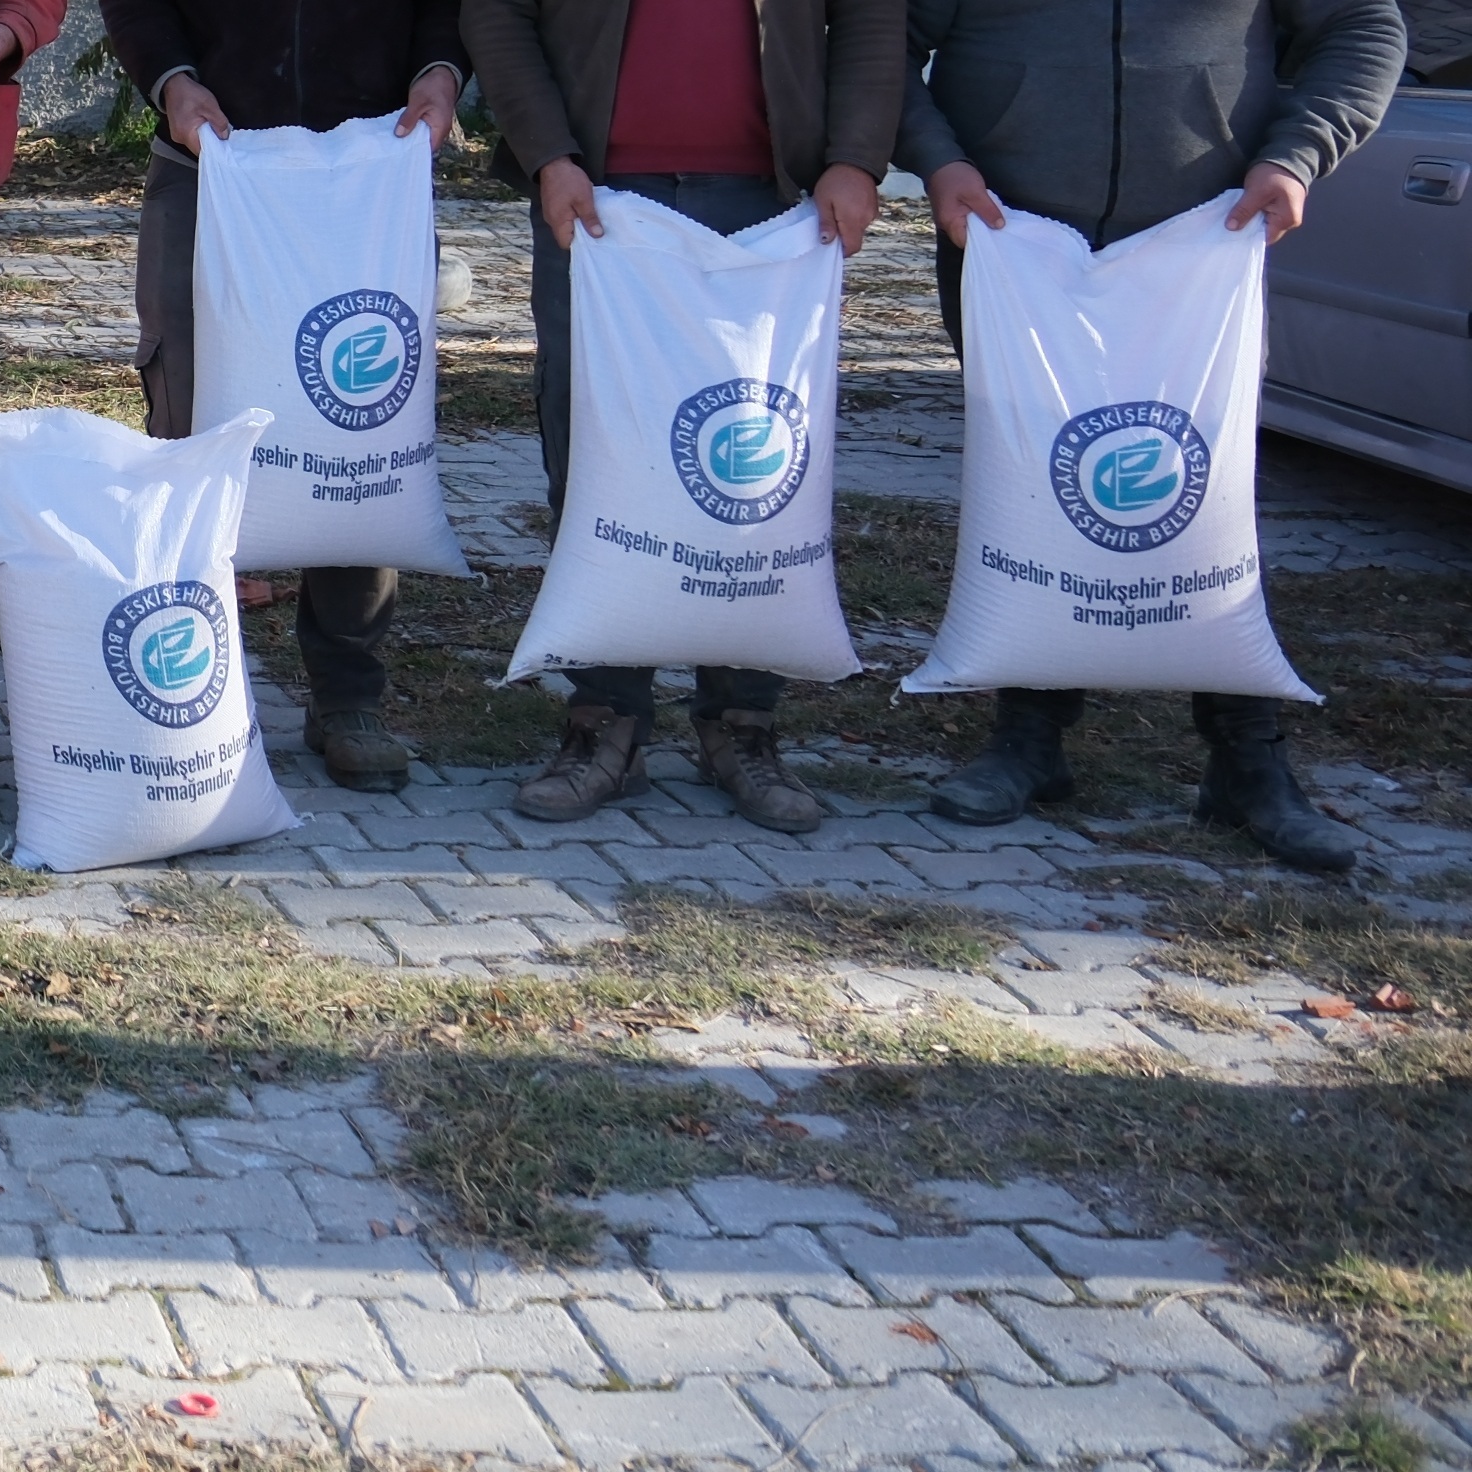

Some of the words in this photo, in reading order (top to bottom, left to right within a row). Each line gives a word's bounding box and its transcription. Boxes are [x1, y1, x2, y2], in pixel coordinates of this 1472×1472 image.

[319, 295, 400, 324] ESKİŞEHİR
[300, 333, 368, 427] BÜYÜKŞEHİR
[376, 330, 419, 422] BELEDİYESİ
[1078, 407, 1183, 437] ESKİŞEHİR
[250, 444, 298, 469] işehir
[303, 452, 387, 481] Büyükşehir
[391, 440, 435, 471] Belediyes
[676, 418, 749, 520] BÜYÜKŞEHİR
[313, 475, 403, 505] armağanıdır.
[1056, 445, 1140, 548] BÜYÜKŞEHİR
[1150, 442, 1206, 543] BELEDİYESİ
[595, 518, 668, 558] Eskişehir
[673, 541, 768, 576] Büyükşehir
[681, 575, 785, 602] armağanıdır.
[981, 544, 1055, 587] Eskişehir
[1060, 570, 1166, 605] Büyükşehir
[123, 586, 210, 621] ESKİŞEHİR
[1073, 601, 1191, 631] armağanıdır.
[107, 631, 191, 724] BÜYÜKŞEHİR
[196, 616, 227, 716] BELEDİYESİ
[52, 744, 126, 773] Eskişehir
[130, 750, 215, 779] Büyükşehir
[146, 768, 236, 803] armağanıdır.
